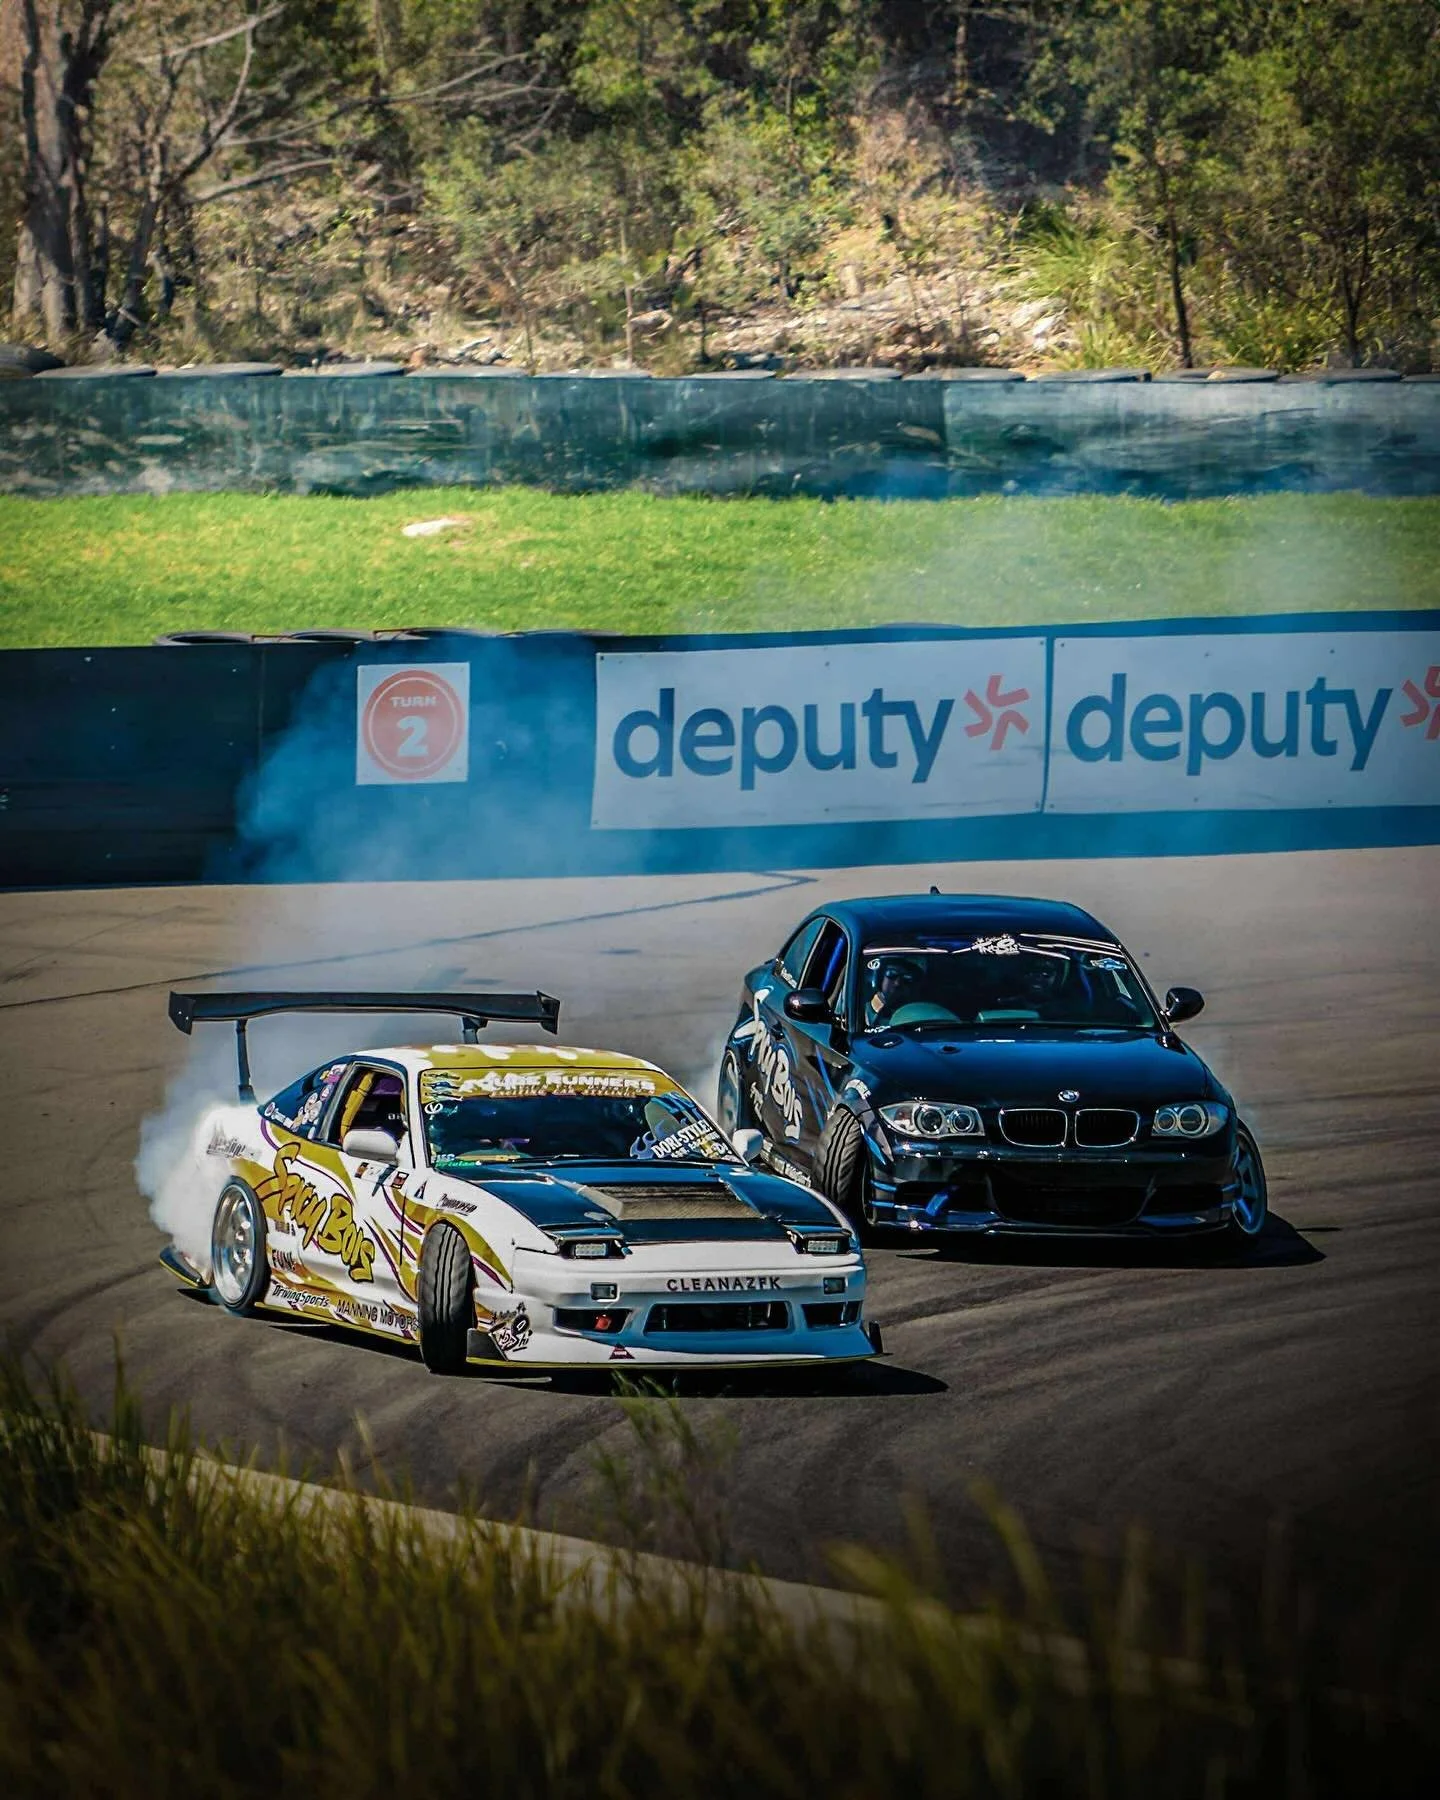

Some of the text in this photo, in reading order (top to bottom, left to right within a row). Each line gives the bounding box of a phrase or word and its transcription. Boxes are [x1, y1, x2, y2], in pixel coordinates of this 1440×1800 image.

[390, 696, 437, 708] TURN
[396, 715, 429, 758] 2
[612, 687, 955, 791] deputy
[1066, 673, 1393, 776] deputy
[336, 1299, 419, 1332] MANNING MOTORS
